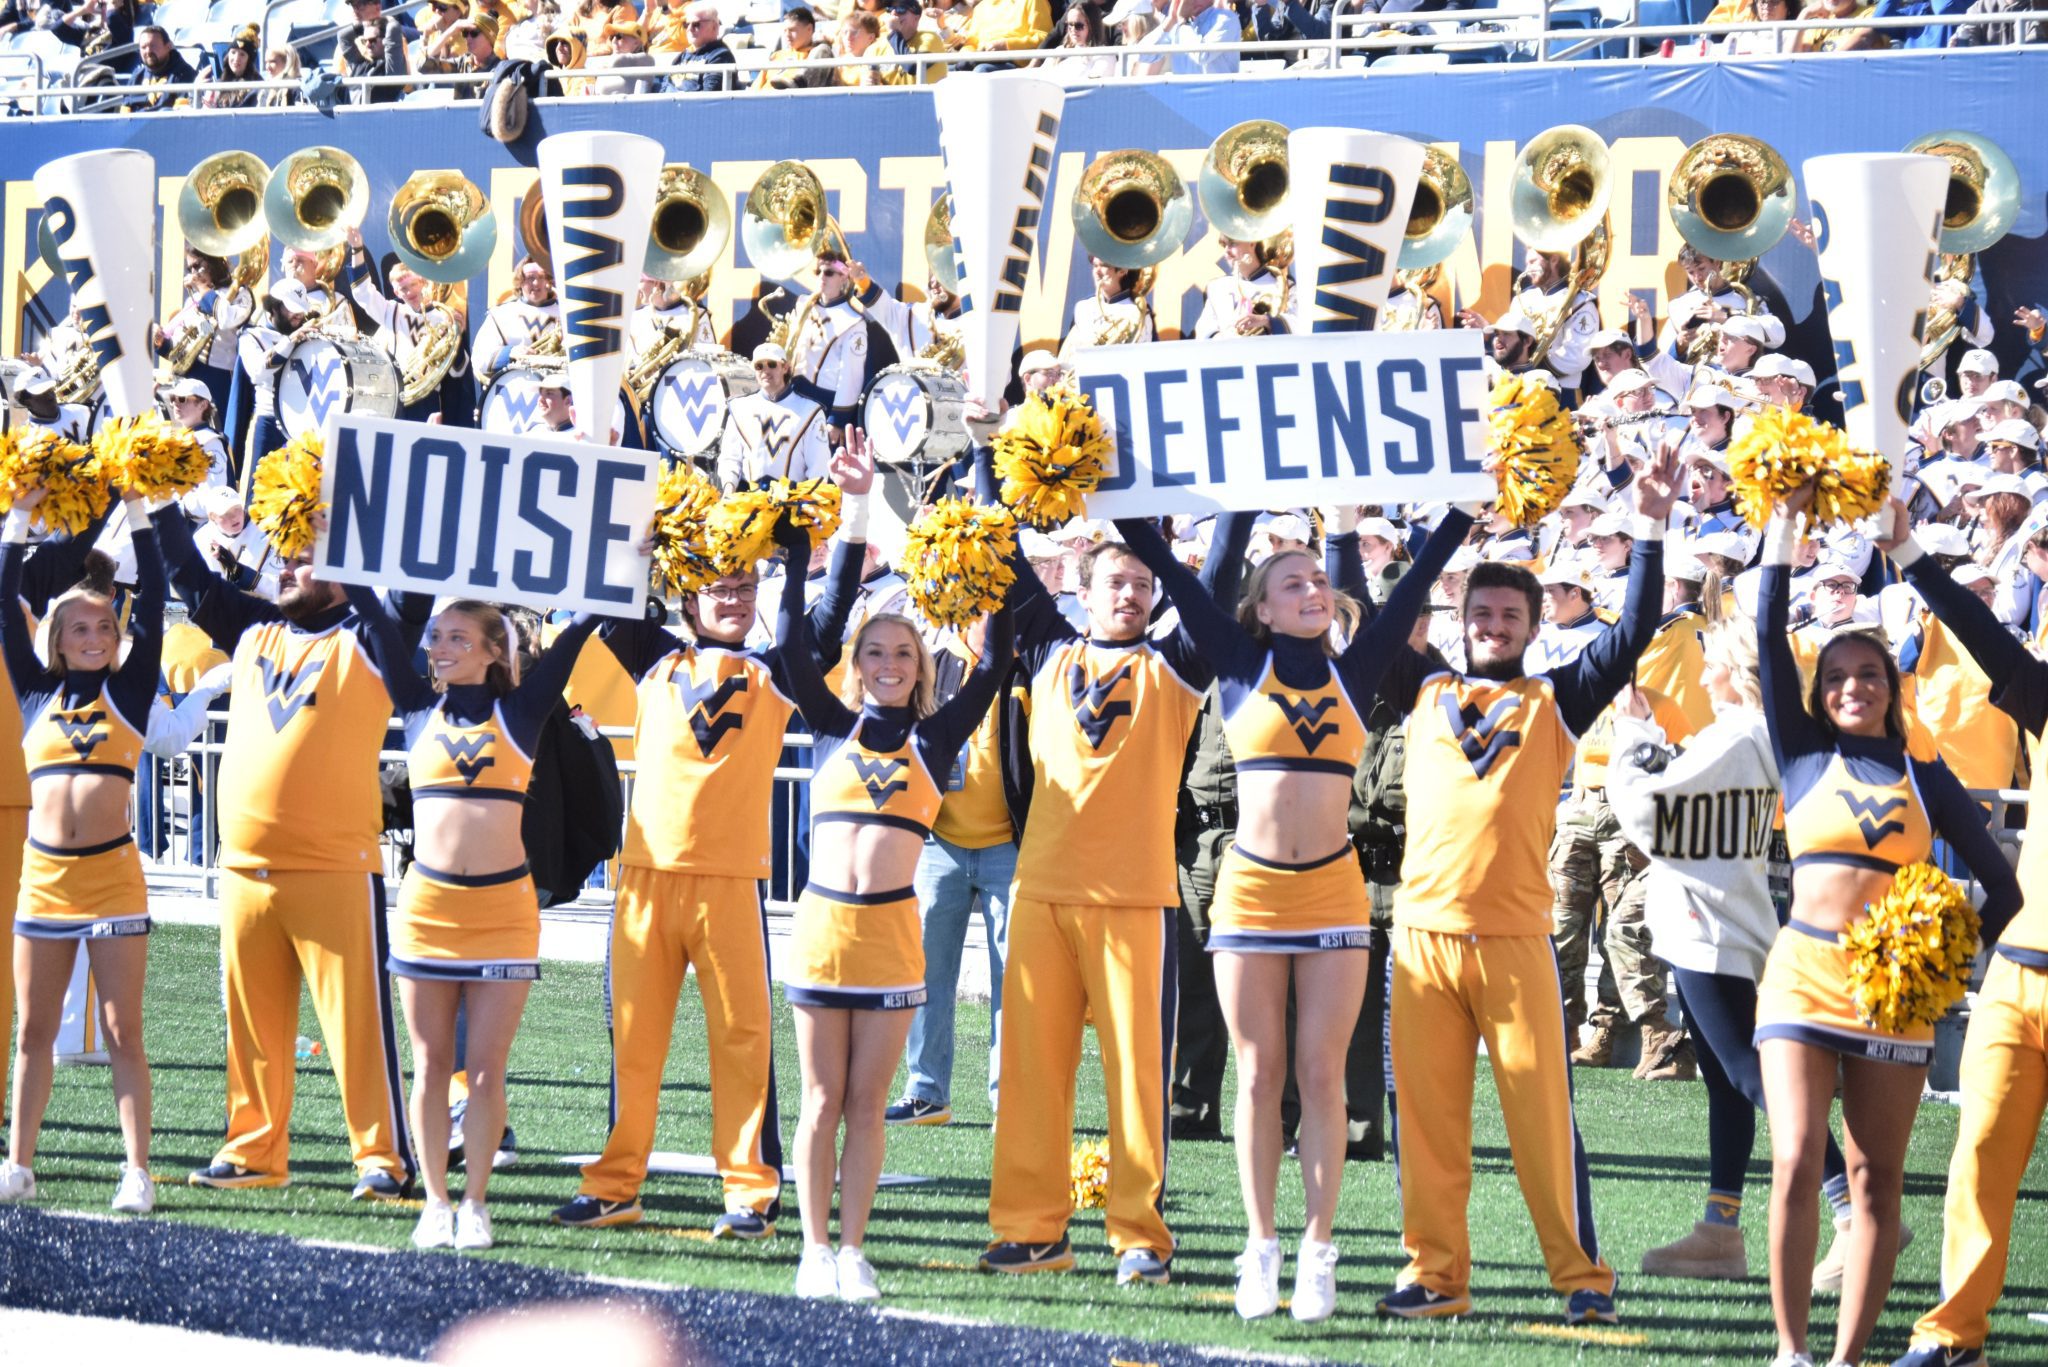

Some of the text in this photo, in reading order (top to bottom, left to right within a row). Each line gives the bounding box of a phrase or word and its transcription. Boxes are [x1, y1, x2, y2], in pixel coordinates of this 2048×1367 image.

[561, 162, 626, 363] WVU
[1078, 356, 1484, 492] DEFENSE
[326, 427, 646, 604] NOISE
[1319, 932, 1343, 949] WEST
[482, 966, 537, 979] WEST VIRGINIA
[883, 992, 905, 1009] WEST
[1866, 1039, 1928, 1064] WEST VIRGINIA
